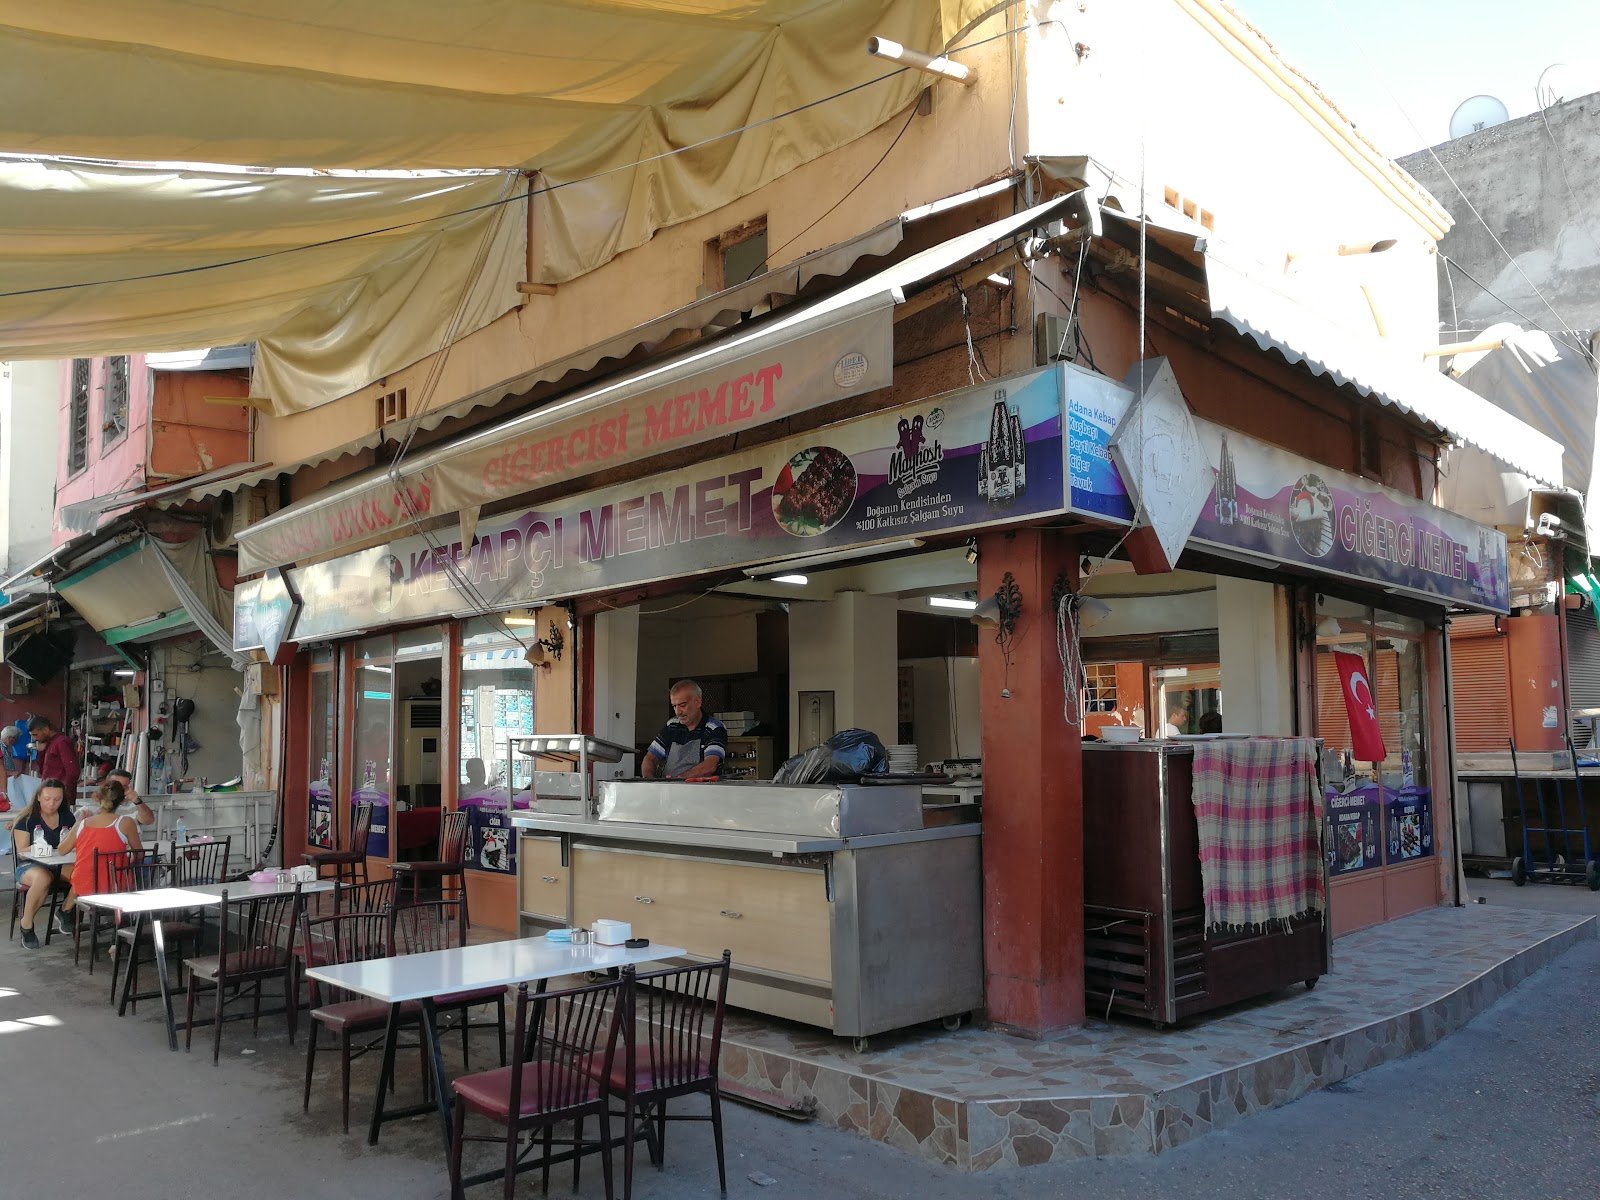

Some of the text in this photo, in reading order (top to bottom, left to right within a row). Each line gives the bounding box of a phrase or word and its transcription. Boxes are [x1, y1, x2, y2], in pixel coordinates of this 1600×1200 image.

[643, 362, 782, 446] MEMET
[1069, 399, 1117, 428] Adana Kebap
[1069, 416, 1098, 440] Kuşbaşı
[1069, 435, 1113, 464] Beyti Kebap
[1070, 473, 1093, 492] Tavuk
[856, 504, 964, 531] %100 Katkısız Şalgam Suyu
[866, 492, 952, 518] Doğanın Kendisinden
[408, 517, 564, 597] KEBAPÇI
[579, 466, 763, 564] MEMET
[1340, 496, 1468, 581] CİĞERCİ MEMET
